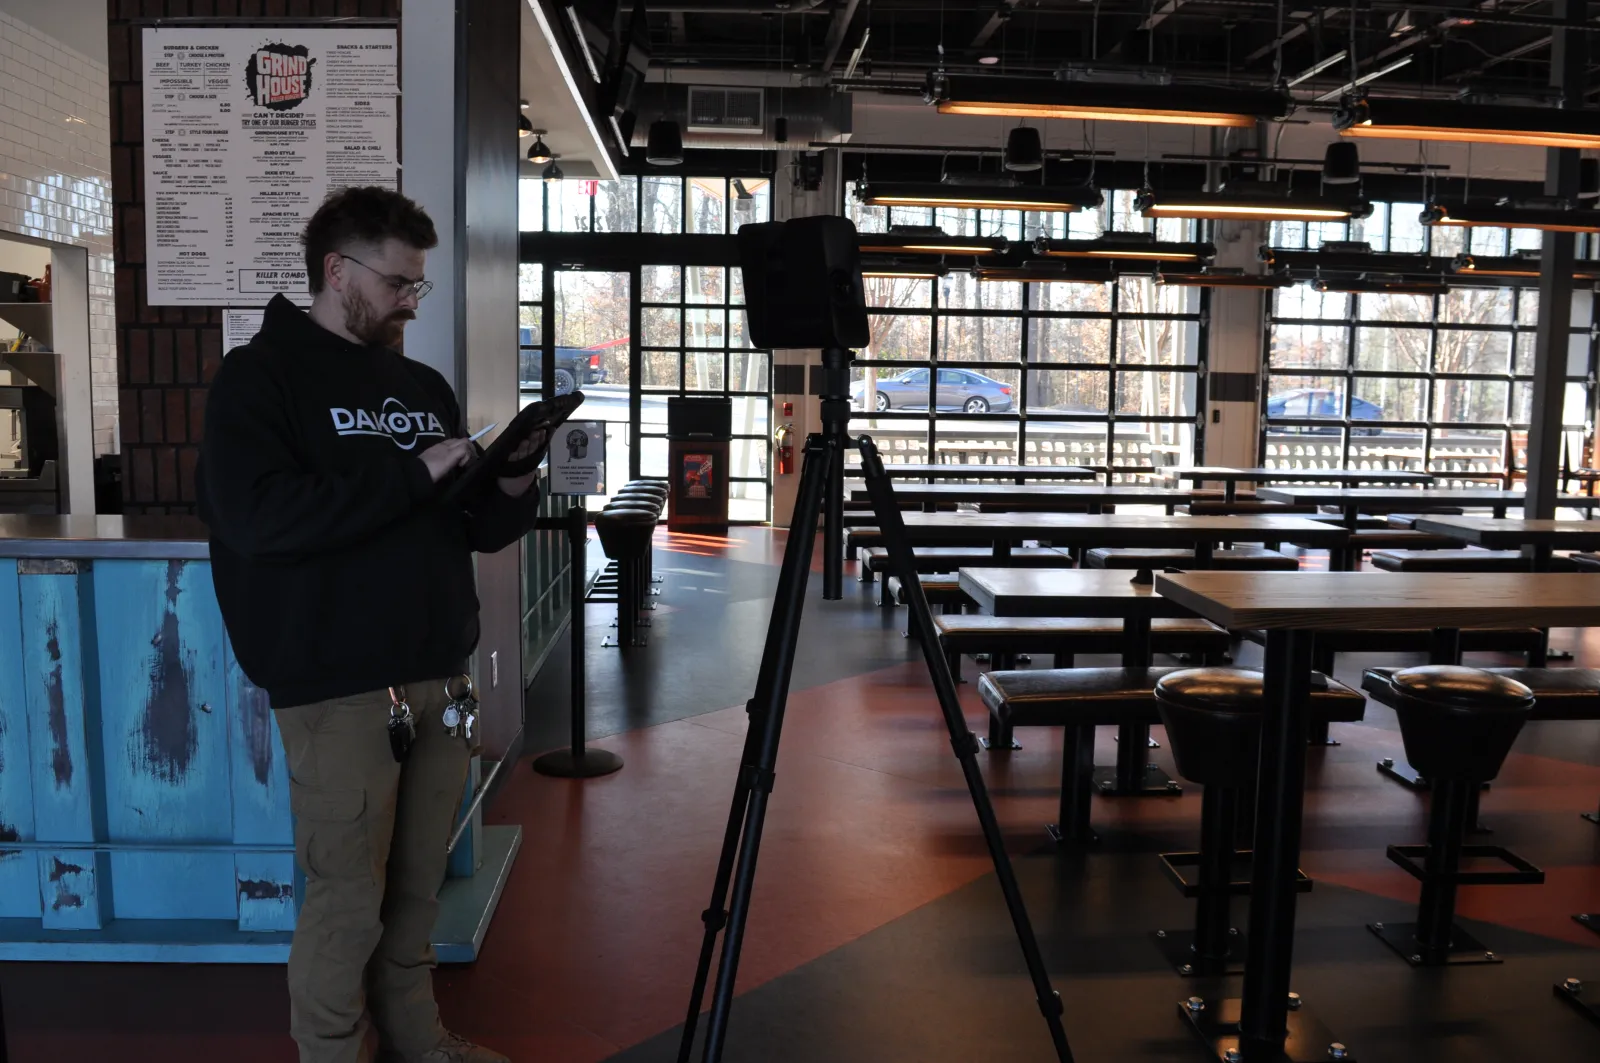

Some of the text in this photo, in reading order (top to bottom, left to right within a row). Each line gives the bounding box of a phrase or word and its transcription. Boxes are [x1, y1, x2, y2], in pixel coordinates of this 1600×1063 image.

[256, 50, 307, 76] GRIND
[256, 76, 306, 105] HOUSE
[330, 408, 444, 434] DAKOTA
